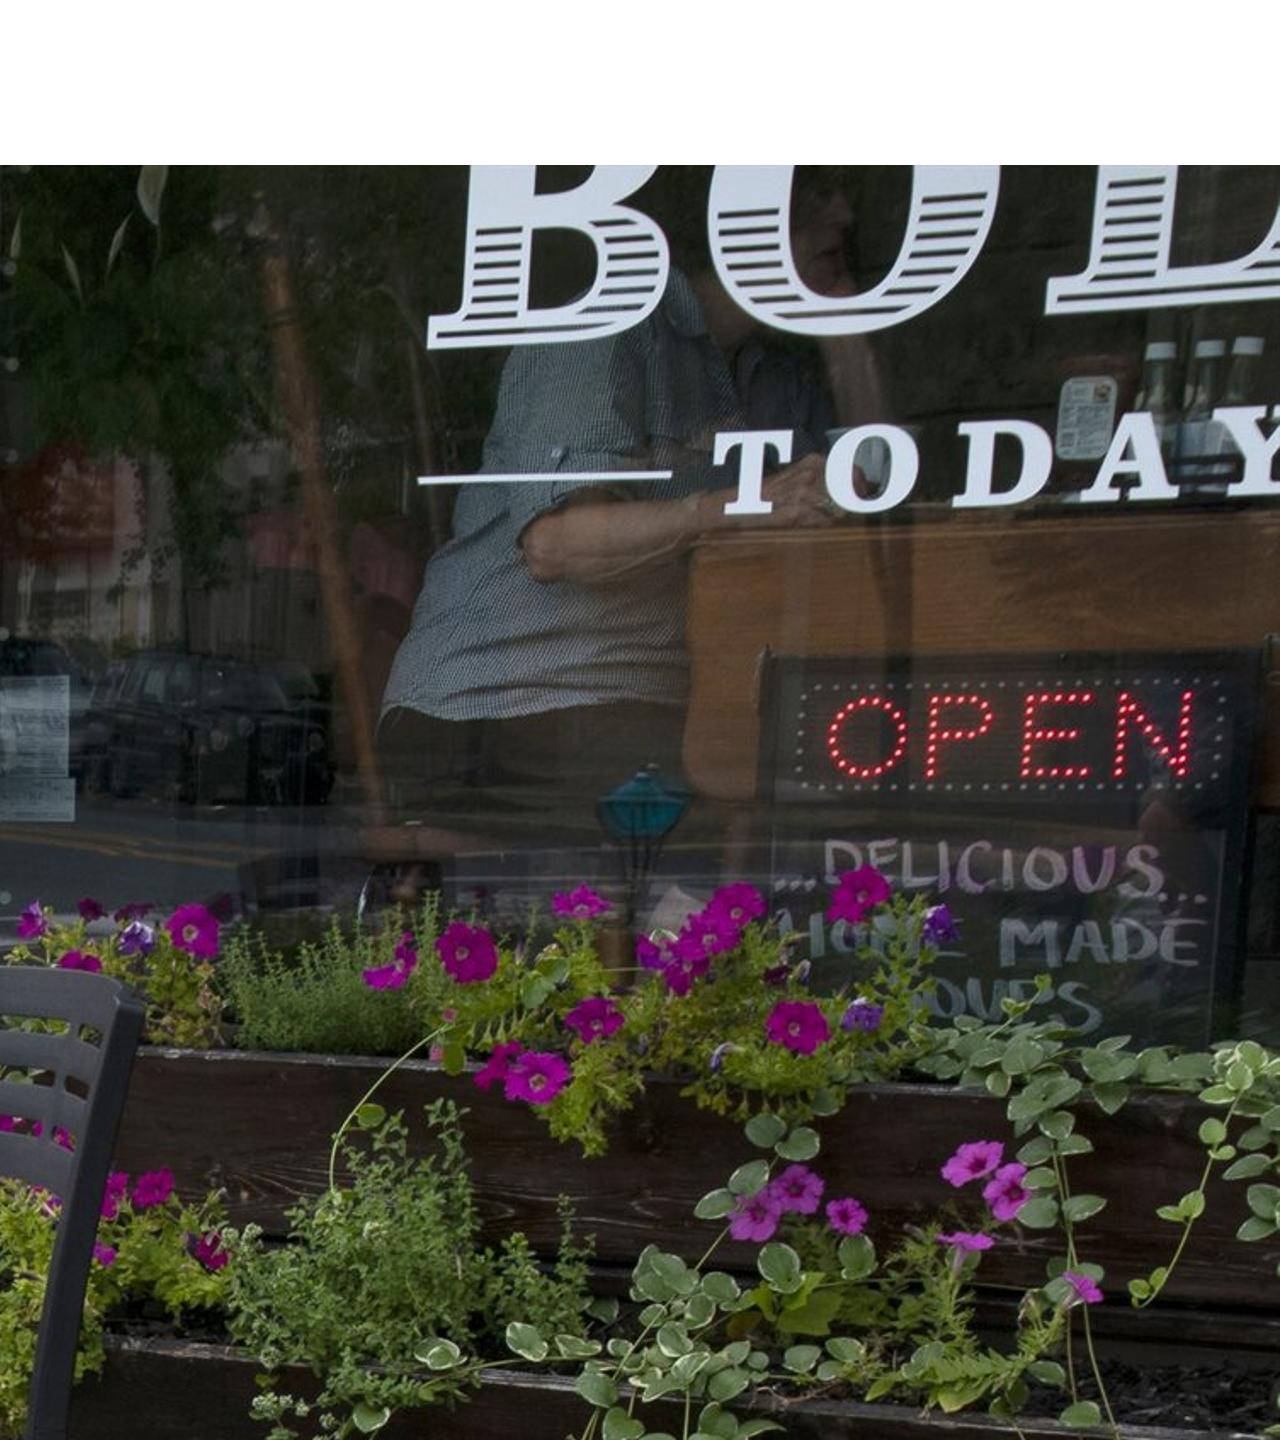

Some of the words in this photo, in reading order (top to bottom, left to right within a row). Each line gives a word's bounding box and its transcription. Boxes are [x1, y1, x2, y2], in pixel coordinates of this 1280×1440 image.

[713, 404, 1280, 516] TODAY
[827, 690, 1196, 779] OPEN
[999, 916, 1208, 968] MADE
[912, 978, 1102, 1034] OUPS
